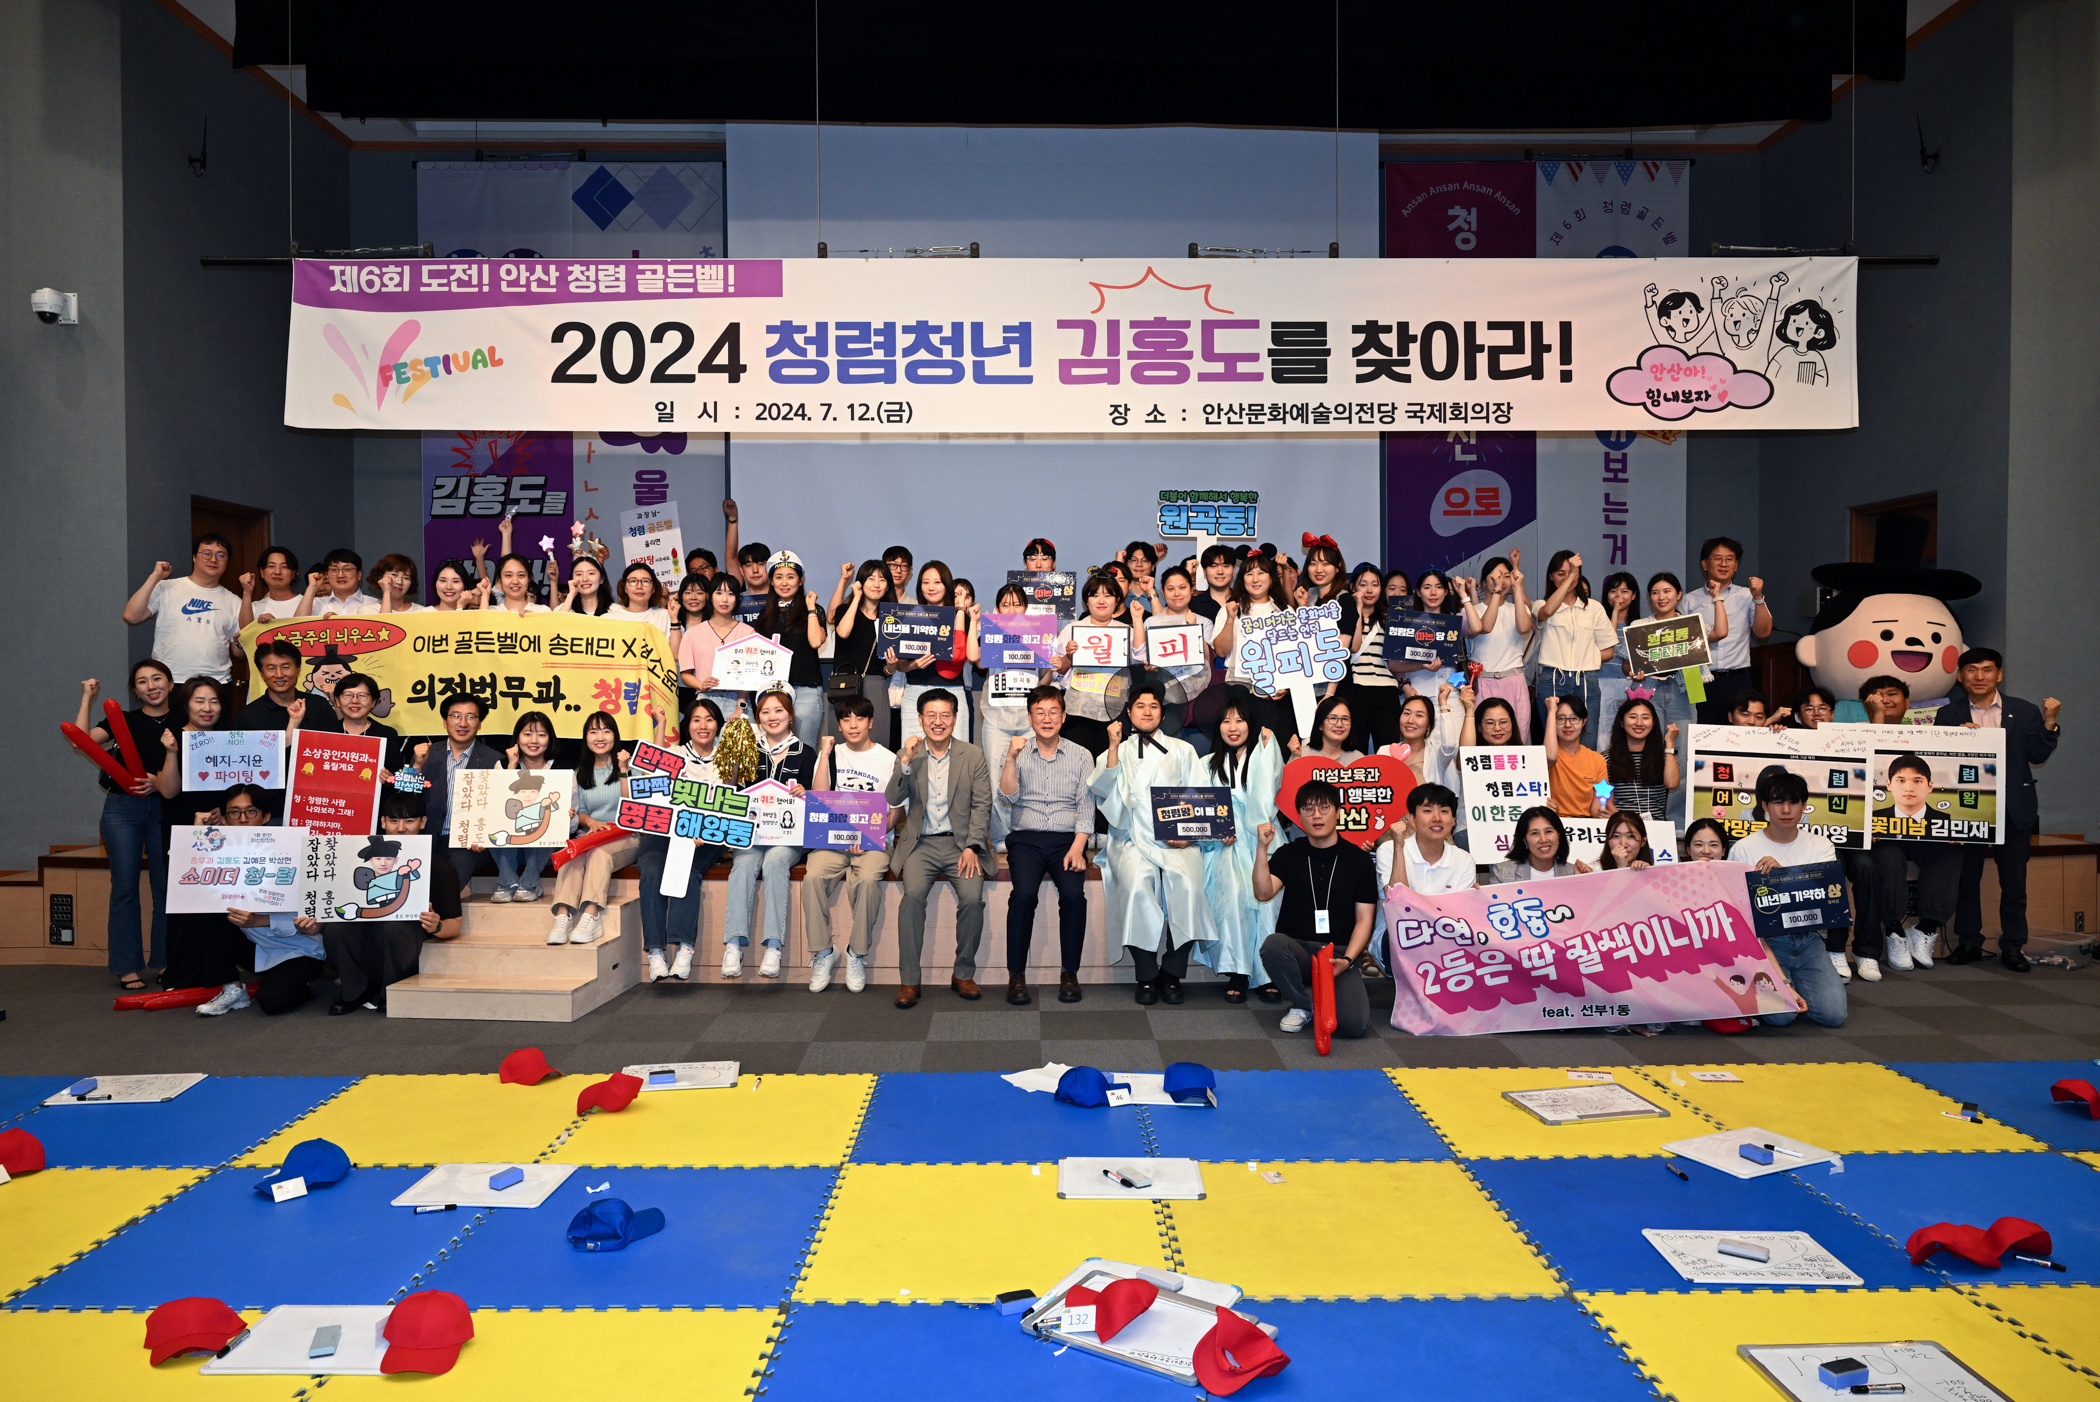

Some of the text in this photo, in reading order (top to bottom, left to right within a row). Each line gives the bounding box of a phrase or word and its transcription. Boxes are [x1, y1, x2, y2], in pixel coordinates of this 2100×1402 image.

[1401, 180, 1521, 218] Ansan Ansan Ansan Ansan
[329, 263, 735, 294] 제6회 도전! 안산 청렴 골든벨!
[550, 316, 1573, 385] 2024 청렴청년 김홍도를 찾아라!
[379, 346, 504, 388] FESTIVAL
[1650, 362, 1706, 380] 안산아!
[1646, 387, 1711, 407] 힘내보자
[755, 402, 812, 422] 2024.
[821, 403, 838, 421] 7.
[846, 401, 913, 424] 12.(금)
[1202, 402, 1398, 425] 안산문화예술의전당
[1404, 402, 1513, 425] 국제회의장
[430, 474, 568, 518] 김홍도를
[1160, 490, 1259, 504] 더불어 함께해서 행복한
[1443, 487, 1502, 516] 으로
[629, 519, 673, 537] 청렴 골든벨
[1159, 505, 1257, 536] 원곡동!
[1063, 585, 1074, 596] 상
[188, 598, 213, 609] NIKE
[1242, 617, 1264, 634] 꿈이
[1297, 601, 1340, 622] 문화마을
[288, 627, 376, 648] 금주의 늬우스
[939, 625, 951, 636] 상
[1022, 634, 1041, 644] 최고
[1299, 621, 1321, 639] 언덕
[1446, 630, 1458, 641] 상
[1648, 627, 1689, 647] 원곡동
[413, 632, 450, 654] 이번
[454, 629, 541, 656] 골든벨에
[547, 632, 615, 658] 송태민
[745, 647, 758, 655] 퀴즈
[904, 643, 928, 652] 100,000
[1082, 633, 1112, 665] 월
[1158, 633, 1188, 664] 피
[1240, 628, 1348, 695] 월피동
[1409, 650, 1434, 659] 300,000
[190, 736, 215, 751] ZERO!!
[259, 739, 276, 750] NO!!
[229, 731, 244, 739] 청탁
[322, 761, 354, 772] 울릴게요
[632, 742, 687, 780] 반짝
[1465, 754, 1526, 772] 청렴돌풍!
[214, 770, 254, 783] 파이팅
[1312, 767, 1381, 783] 여성보육과
[1717, 766, 1845, 786] 청 렴
[1962, 768, 1975, 781] 렴
[393, 781, 424, 794] 박성현
[630, 776, 751, 817] 반짝 빛나는
[1347, 787, 1393, 804] 행복한
[1485, 781, 1547, 797] 청렴스타!
[307, 795, 329, 806] 청렴한
[330, 798, 346, 807] 사람
[472, 769, 490, 845] 찾았다 홍도
[760, 795, 775, 804] 퀴즈
[1716, 791, 1729, 804] 여
[1832, 796, 1844, 810] 신
[1963, 792, 1976, 805] 왕
[305, 805, 355, 817] 나와보라 그래!
[457, 771, 476, 848] 잡았다 청렴
[849, 813, 869, 824] 최고
[870, 812, 883, 825] 상
[1216, 804, 1229, 817] 상
[618, 799, 755, 848] 명품 해양동
[1871, 816, 1989, 839] 꽃미남 김민재
[833, 834, 859, 842] 100,000
[243, 857, 267, 865] 김예은
[269, 857, 292, 865] 박성현
[179, 866, 298, 886] 쇼미더 청-렴
[304, 837, 321, 919] 잡았다 청렴
[320, 837, 339, 920] 찾았다 홍도
[1757, 884, 1842, 908] 내년을 기약하 상
[1789, 913, 1818, 924] 100,000
[1416, 902, 1737, 996] 2등은 딱 질색이니까
[1542, 1002, 1631, 1018] feat. 선부1동
[1068, 1313, 1089, 1326] 132
